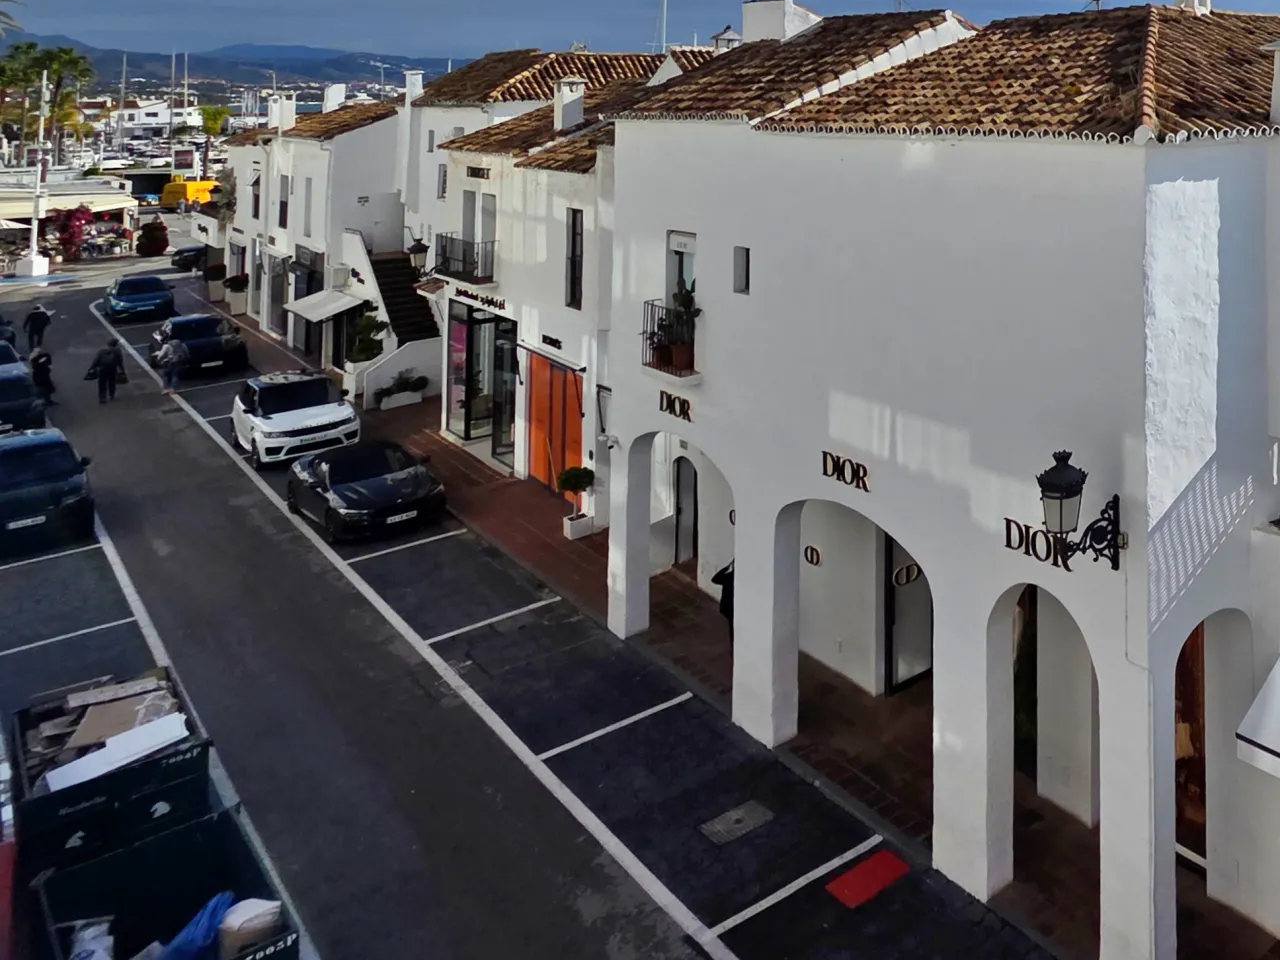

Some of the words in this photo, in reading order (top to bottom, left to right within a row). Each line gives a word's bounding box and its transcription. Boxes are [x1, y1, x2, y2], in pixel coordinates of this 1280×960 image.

[659, 390, 692, 422] DIOR
[821, 450, 871, 493] DIOR
[1003, 517, 1074, 572] DIOR
